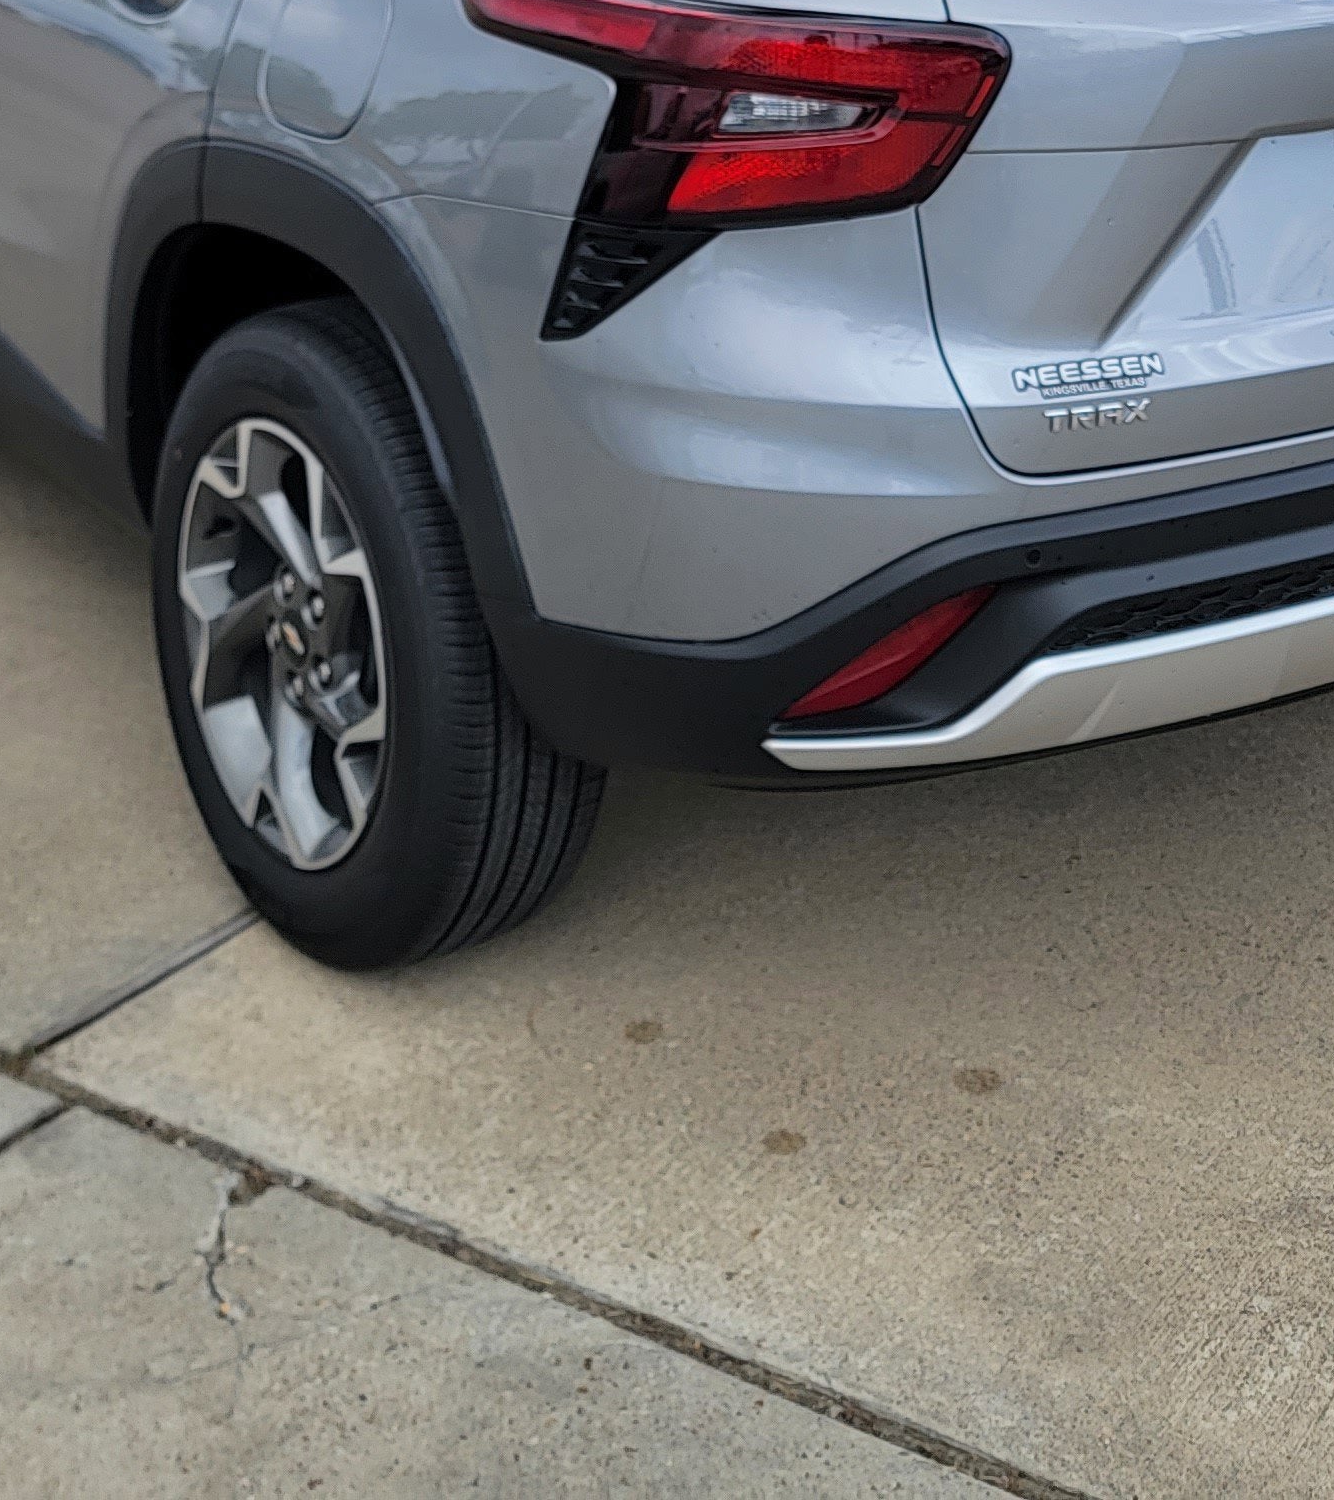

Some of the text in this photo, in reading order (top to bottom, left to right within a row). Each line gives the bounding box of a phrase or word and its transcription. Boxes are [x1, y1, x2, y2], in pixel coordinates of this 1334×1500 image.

[1012, 353, 1165, 392] NEESSEN
[1111, 376, 1146, 389] TEXAS
[1042, 398, 1151, 433] TRAX
